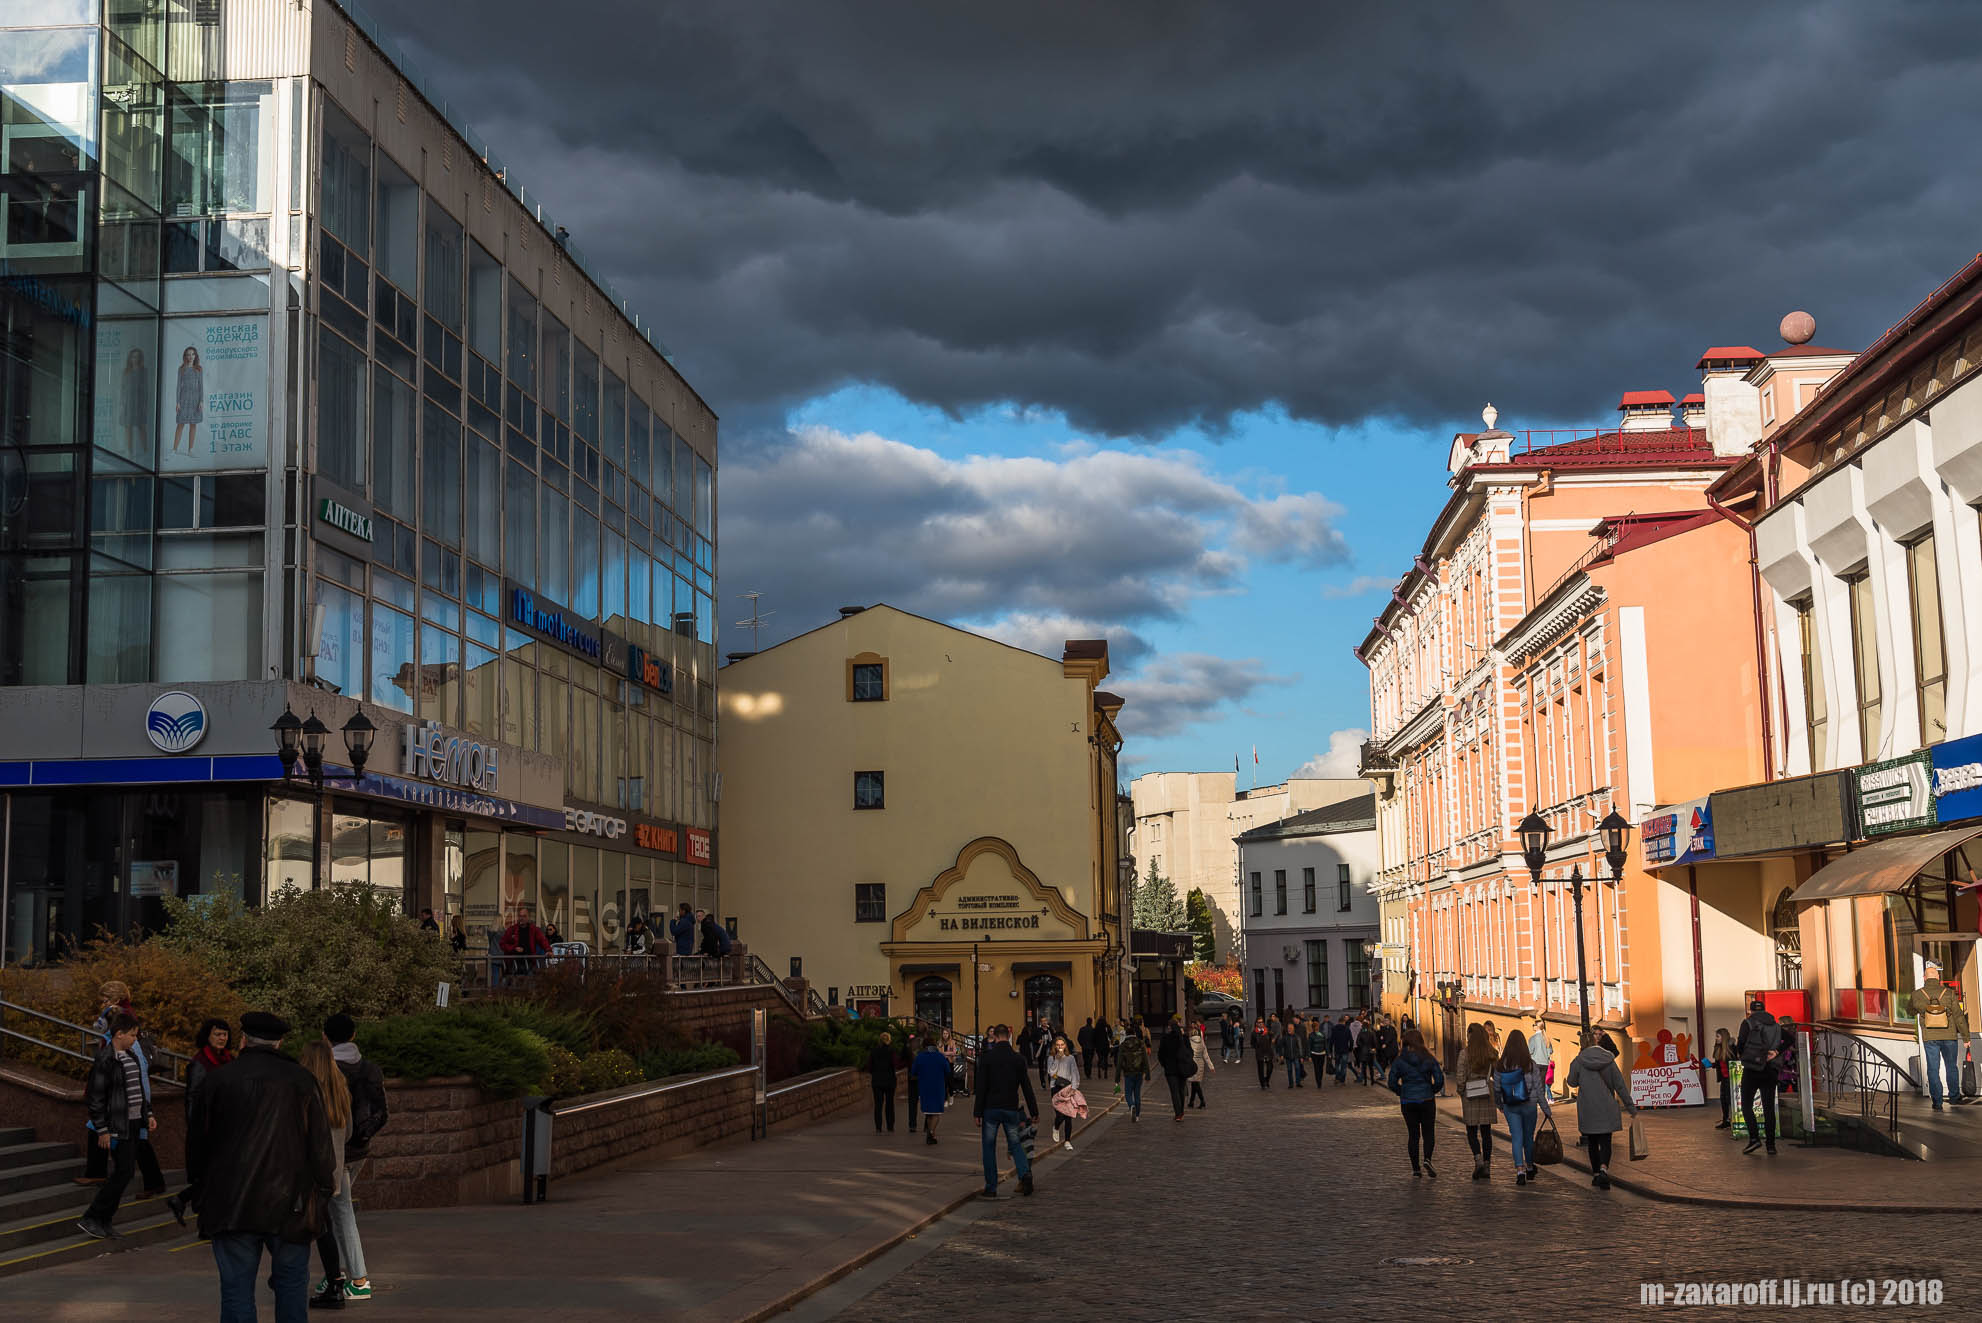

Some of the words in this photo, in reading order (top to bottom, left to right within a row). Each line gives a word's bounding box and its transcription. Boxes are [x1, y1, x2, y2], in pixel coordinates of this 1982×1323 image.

[207, 324, 257, 335] женская
[207, 332, 257, 344] одежда
[209, 392, 253, 400] магазин
[209, 399, 253, 411] FAYNO
[210, 441, 216, 453] 1
[221, 442, 252, 452] этаж
[325, 499, 374, 541] АПТЕКА
[536, 609, 601, 658] mothercare
[563, 806, 627, 839] EGATOP
[651, 825, 677, 854] КНИГИ
[940, 919, 959, 930] НА
[961, 915, 1040, 930] ВИЛЕНСКОЙ
[847, 984, 894, 997] АПТЭКА
[1647, 1067, 1673, 1078] 4000
[1632, 1078, 1660, 1086] НУЖНЫХ
[1633, 1084, 1655, 1092] ВЕЩЕЙ
[1668, 1080, 1686, 1104] 2
